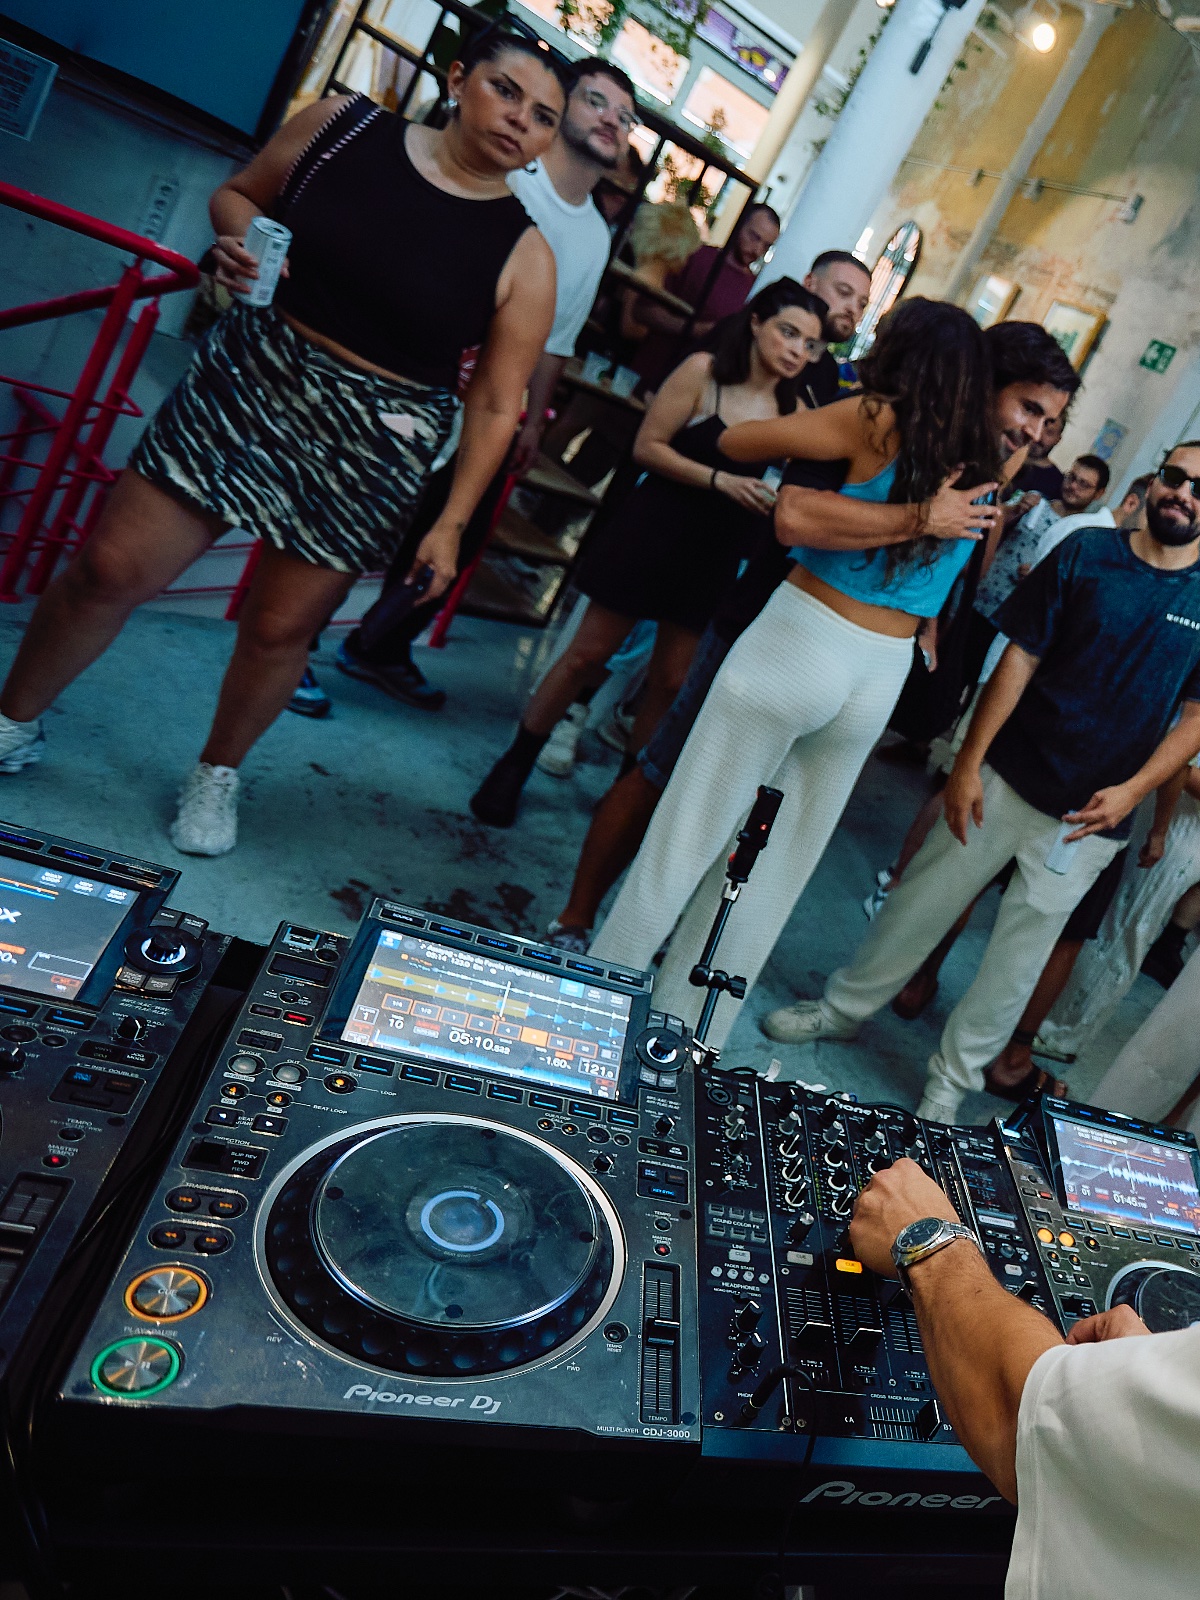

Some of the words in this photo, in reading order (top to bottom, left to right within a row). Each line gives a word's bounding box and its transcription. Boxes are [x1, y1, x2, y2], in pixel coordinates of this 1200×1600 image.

[713, 1217, 732, 1225] SOUND
[733, 1220, 752, 1228] COLOR
[722, 1282, 760, 1291] HEADPHONES
[266, 1335, 283, 1343] REV
[343, 1384, 466, 1408] Pioneer
[616, 1426, 639, 1434] PLAYER
[642, 1427, 691, 1438] CDJ-3000
[800, 1480, 1002, 1509] Pioneer
